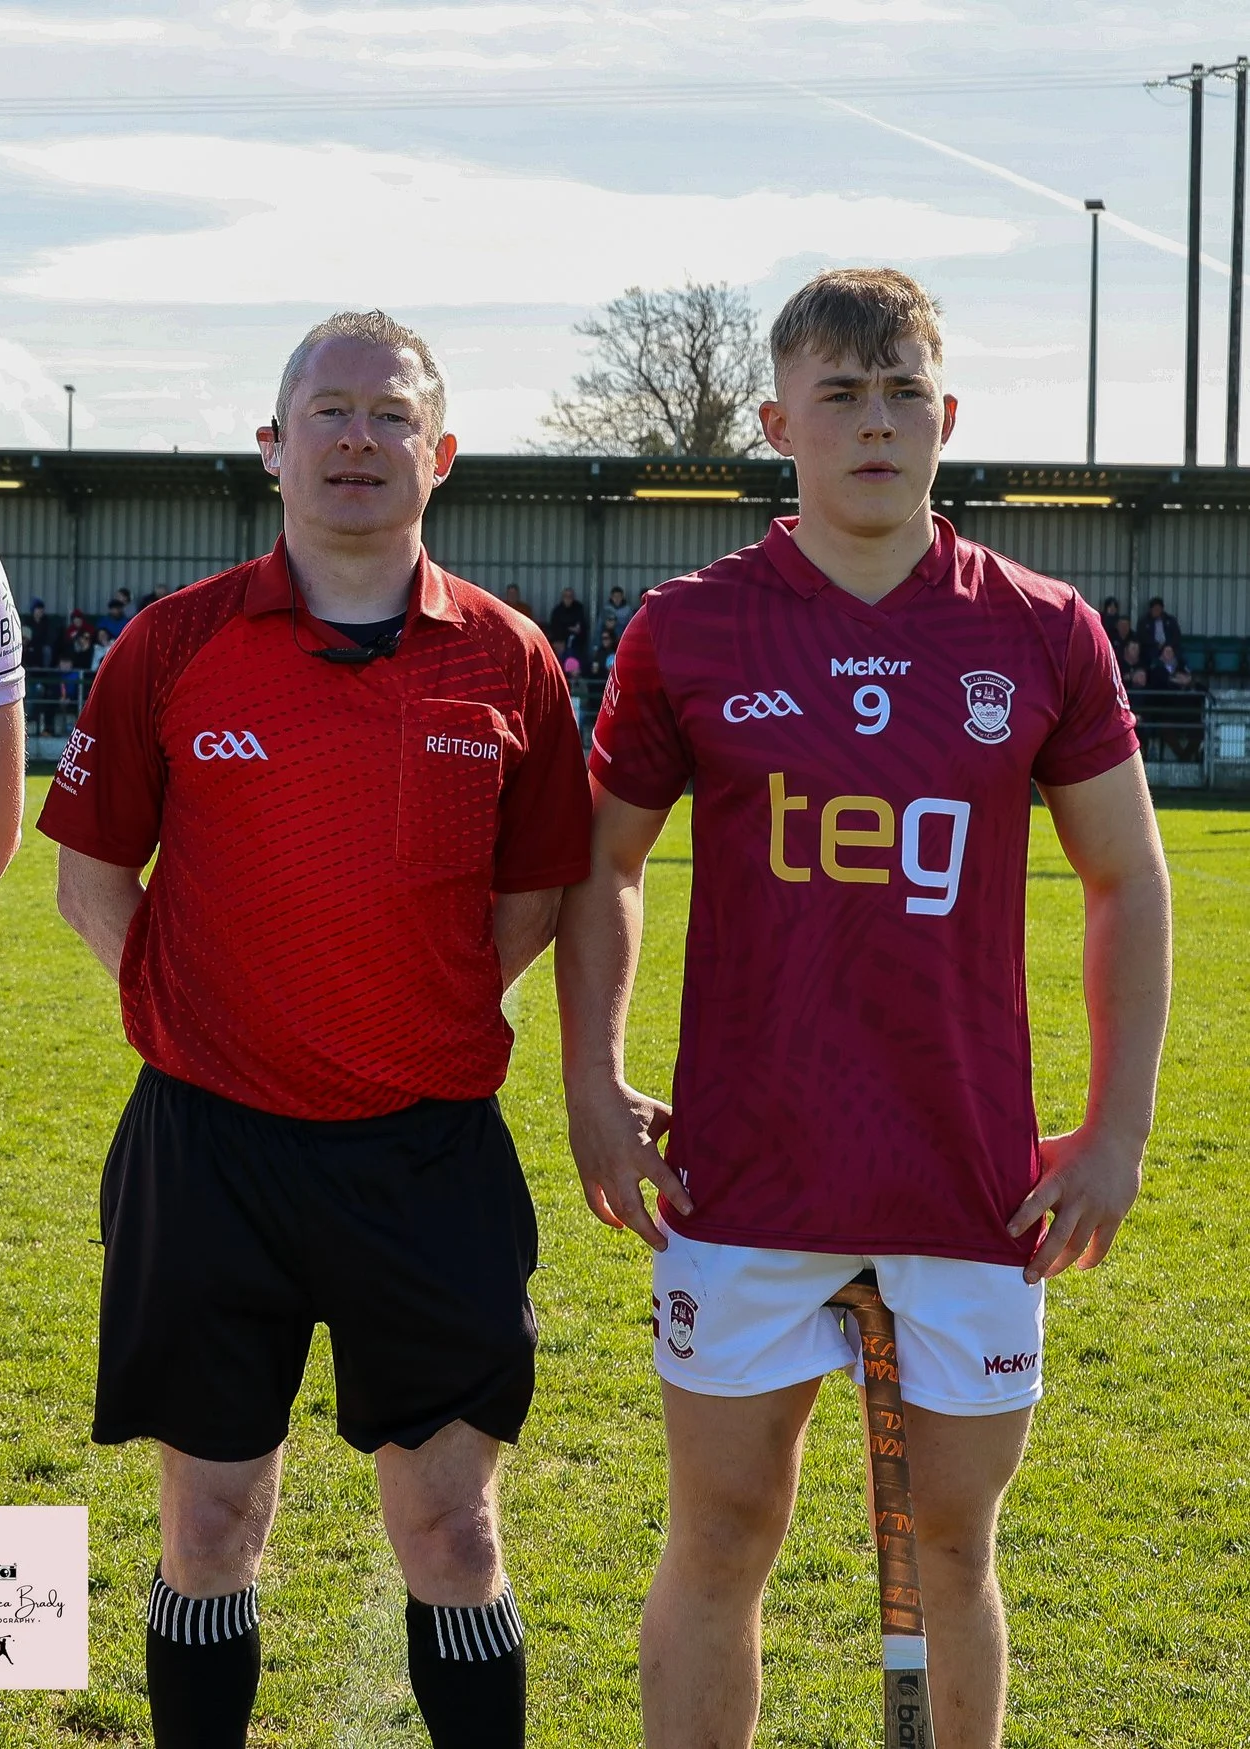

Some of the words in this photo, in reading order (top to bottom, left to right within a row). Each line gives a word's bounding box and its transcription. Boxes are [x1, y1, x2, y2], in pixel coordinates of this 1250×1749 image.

[852, 684, 891, 735] 9
[426, 733, 499, 761] RÉITEOIR
[768, 771, 971, 916] teg
